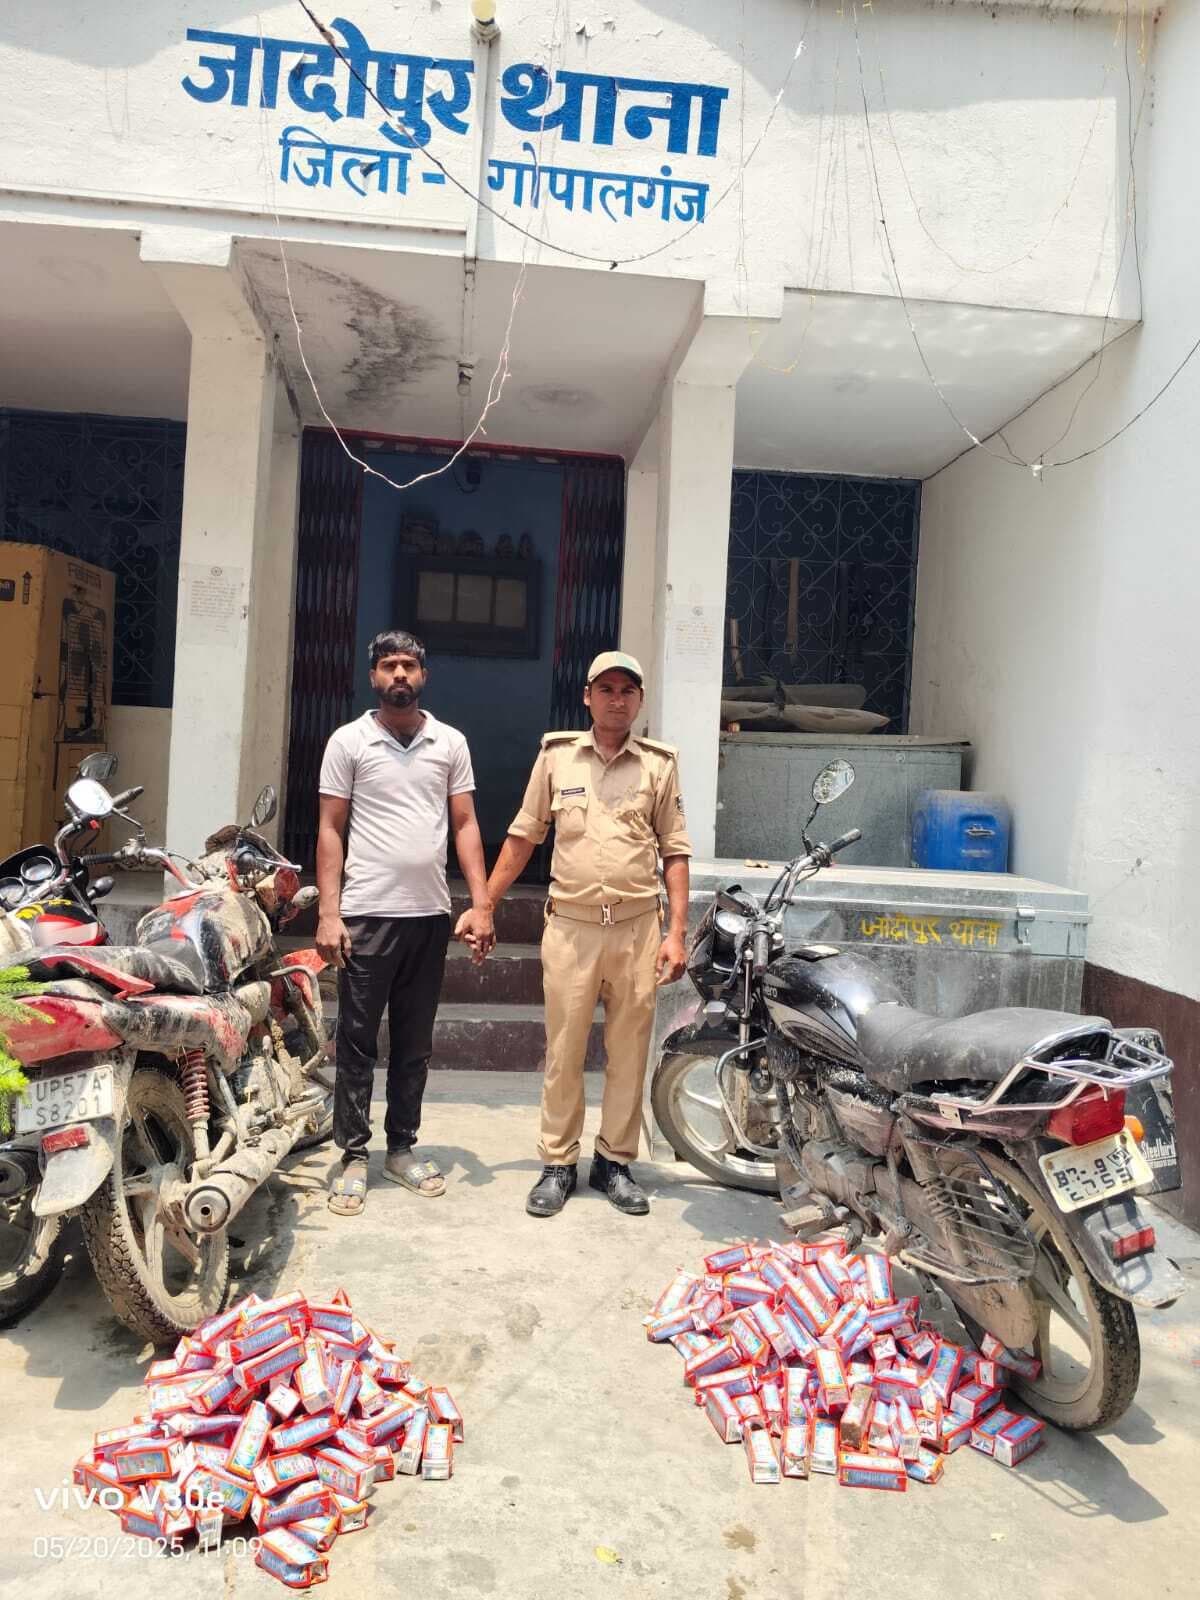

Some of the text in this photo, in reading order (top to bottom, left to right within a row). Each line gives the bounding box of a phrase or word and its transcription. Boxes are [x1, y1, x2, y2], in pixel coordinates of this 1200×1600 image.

[181, 17, 729, 156] जादोपुर थाना
[487, 142, 709, 223] गोपालगंज
